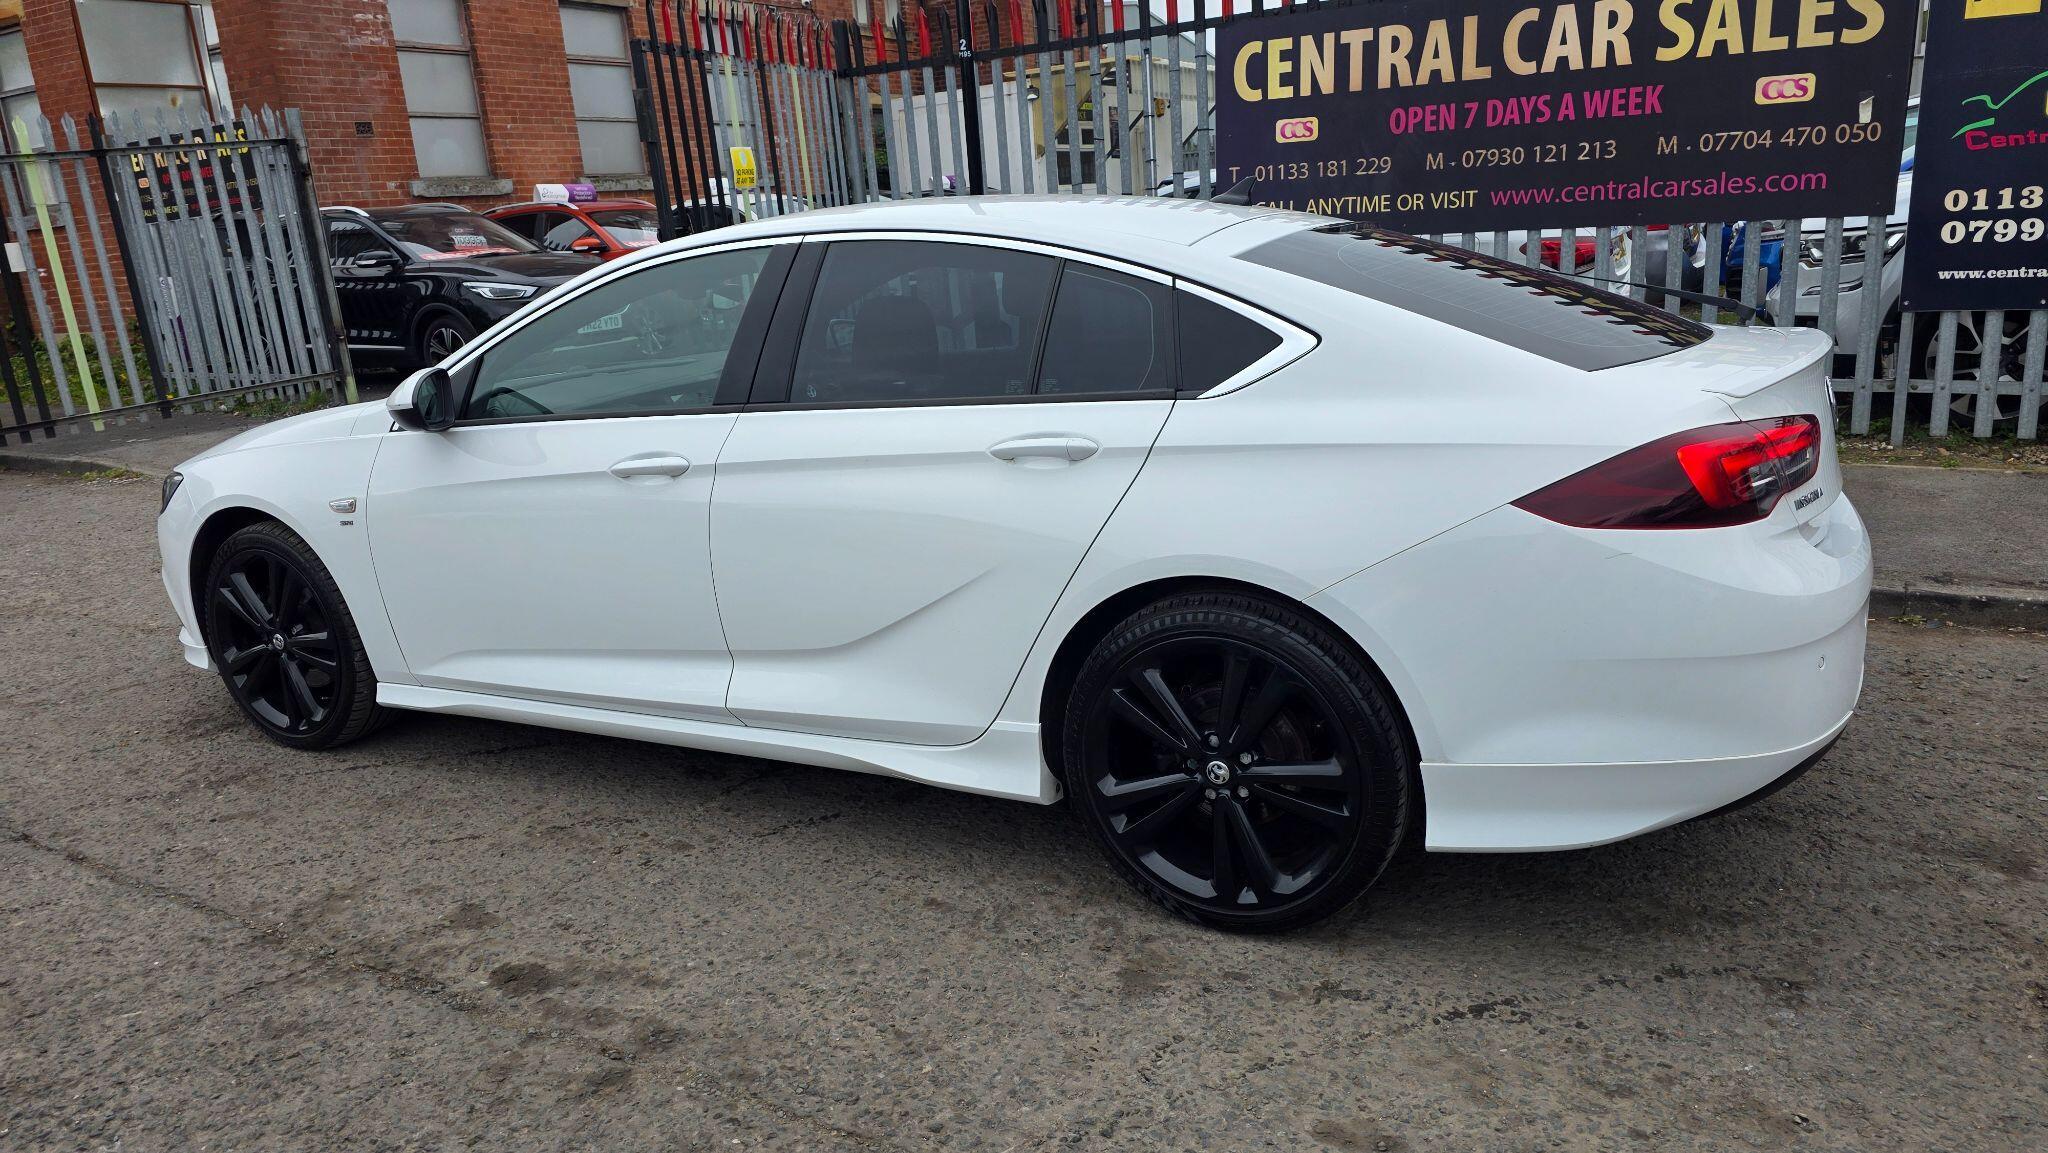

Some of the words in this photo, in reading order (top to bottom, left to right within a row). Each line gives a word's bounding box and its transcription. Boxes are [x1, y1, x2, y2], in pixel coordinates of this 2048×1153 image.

[1234, 15, 1491, 101] CENTRAL
[1503, 1, 1634, 75] CAR
[1655, 0, 1885, 61] SALES
[1390, 103, 1456, 134] OPEN
[1464, 102, 1479, 129] 7
[1486, 94, 1551, 127] DAYS
[1557, 92, 1575, 121] A
[1583, 84, 1664, 118] WEEK
[1657, 135, 1678, 155] M
[1700, 129, 1772, 152] 07704
[1780, 125, 1827, 146] 470
[1835, 121, 1882, 144] 050
[1229, 166, 1241, 183] T
[1255, 162, 1309, 182] 01133
[1317, 159, 1347, 177] 181
[1355, 156, 1392, 175] 229
[1425, 152, 1444, 171] M
[1462, 146, 1524, 168] 07930
[1533, 143, 1567, 163] 121
[1577, 140, 1616, 160] 213
[1306, 194, 1391, 215] ANYTIME
[1397, 193, 1424, 212] OR
[1431, 190, 1478, 210] VISIT
[1490, 171, 1827, 206] www.centralcarsales.com
[1943, 185, 2044, 212] 0113
[1940, 217, 2045, 244] 0799
[1937, 266, 2048, 280] www.centra
